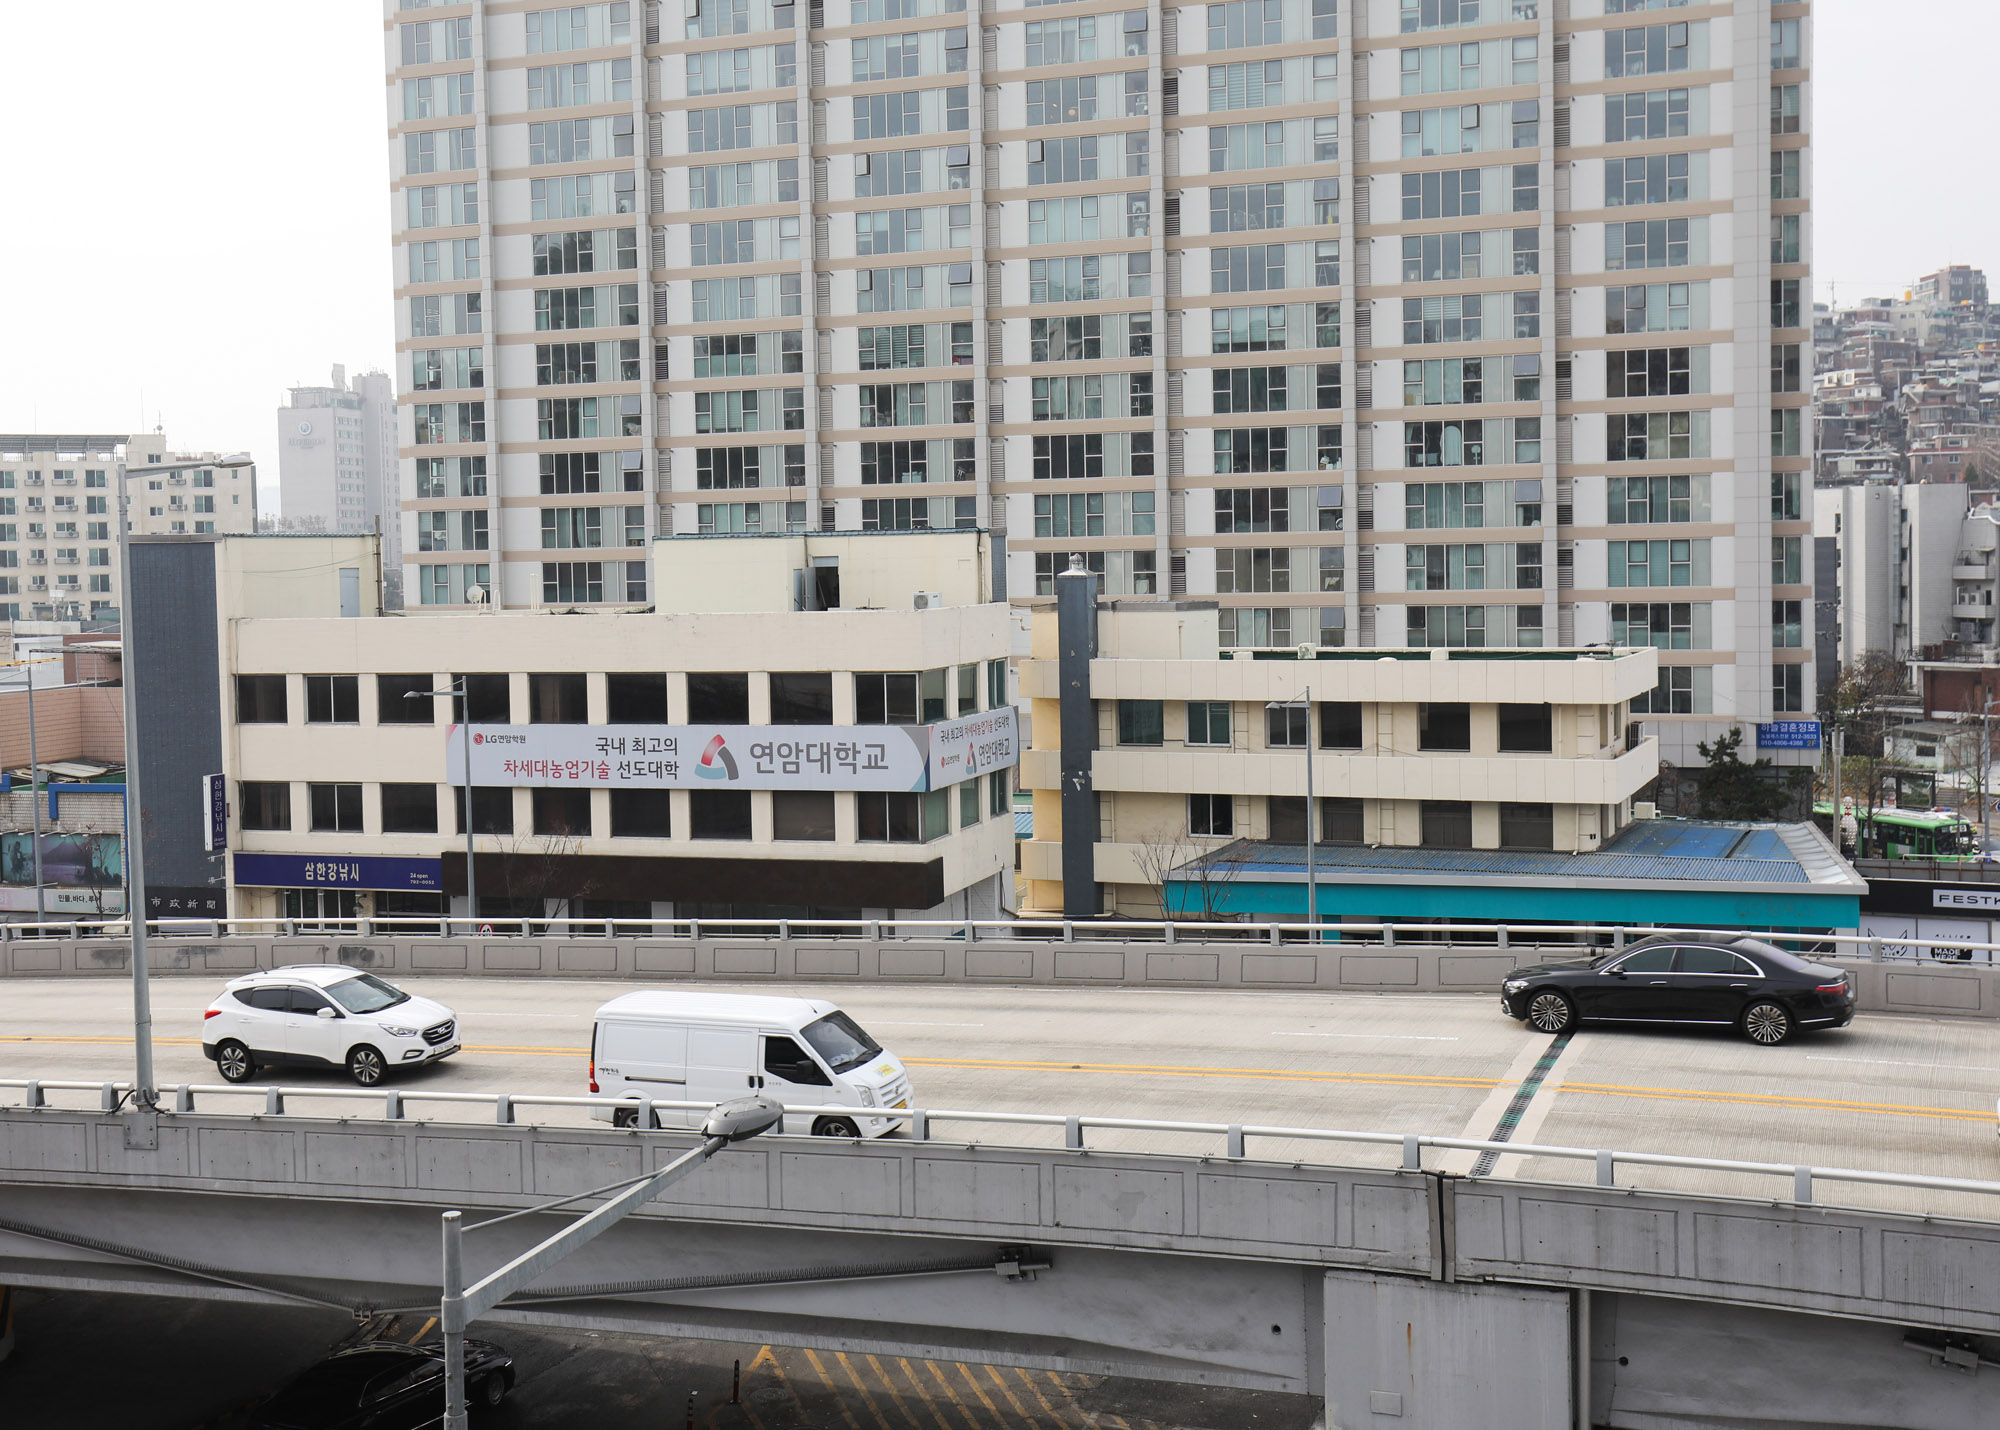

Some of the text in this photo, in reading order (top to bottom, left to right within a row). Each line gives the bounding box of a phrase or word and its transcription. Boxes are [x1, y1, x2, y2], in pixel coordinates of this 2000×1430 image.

[485, 735, 526, 744] LG연암학원
[595, 737, 678, 756] 국내 최고의
[750, 741, 889, 774] 연암대학교
[979, 738, 1010, 767] 연암대학교
[503, 759, 679, 780] 차세대농업기술 선도대학
[214, 780, 223, 832] 삼한강낚시
[305, 862, 360, 881] 삼한강낚시
